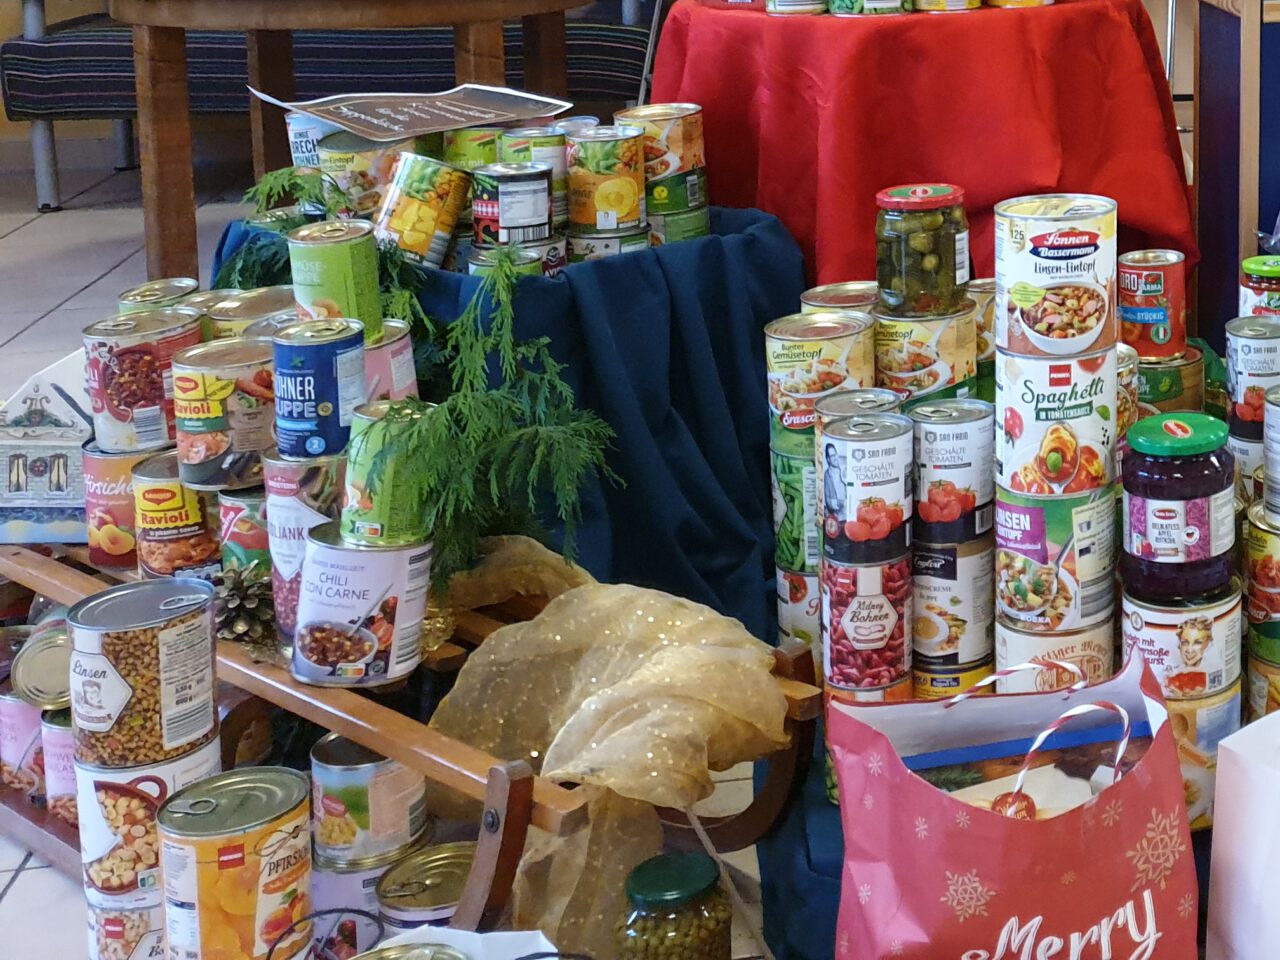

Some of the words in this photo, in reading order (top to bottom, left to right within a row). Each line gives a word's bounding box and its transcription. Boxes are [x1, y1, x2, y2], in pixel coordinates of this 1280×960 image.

[1011, 229, 1025, 241] 125
[1038, 244, 1096, 258] Bassermann
[1034, 259, 1096, 275] Linsen-Eintopf
[1120, 272, 1138, 291] ORO
[781, 343, 804, 351] Bunter
[772, 347, 823, 361] Gemüsetopf
[276, 371, 315, 401] ÜHNER
[1022, 377, 1105, 406] Spaghetti
[939, 433, 952, 442] SAN
[867, 449, 880, 459] SAN
[924, 447, 966, 456] GESCHÄLTE
[927, 455, 964, 463] TOMATEN
[852, 462, 895, 474] GESCHÄLTE
[855, 470, 893, 481] TOMATEN
[141, 510, 189, 525] Ravioli
[318, 571, 349, 587] CHILI
[305, 580, 324, 596] CON
[325, 586, 371, 601] CARNE
[856, 600, 885, 613] Kidney
[849, 610, 889, 623] Bohnen
[1142, 637, 1155, 647] mit
[72, 658, 109, 680] Linsen
[962, 889, 1163, 960] Merry
